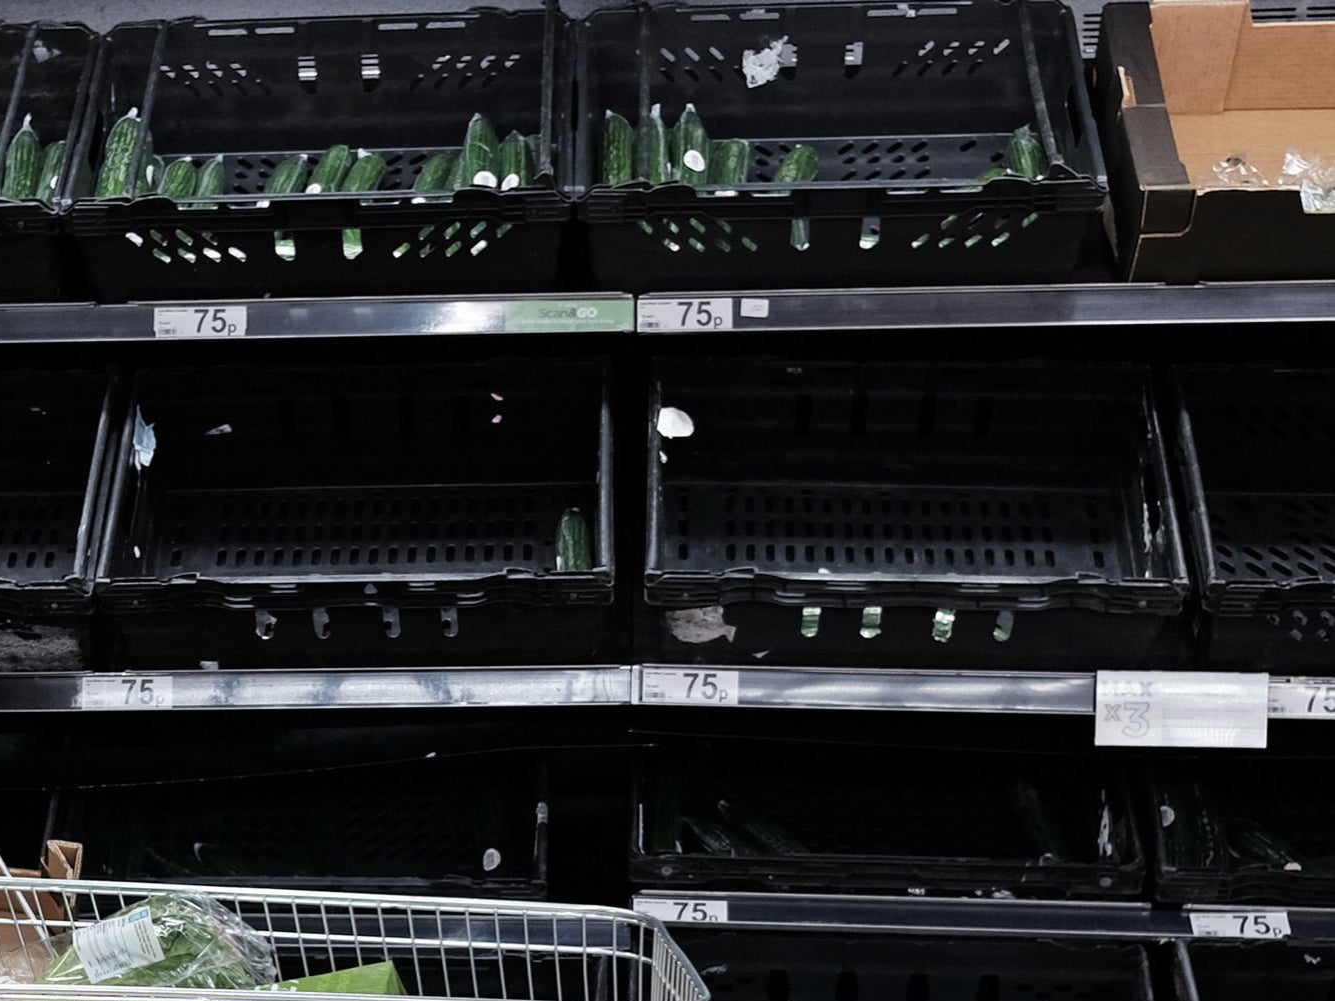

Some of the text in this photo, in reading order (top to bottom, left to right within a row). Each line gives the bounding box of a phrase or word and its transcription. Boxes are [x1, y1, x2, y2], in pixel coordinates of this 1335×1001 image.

[194, 309, 237, 337] 75p
[677, 301, 723, 329] 75p
[121, 679, 165, 707] 75p
[683, 673, 728, 702] 75p
[1232, 915, 1282, 937] 75p
